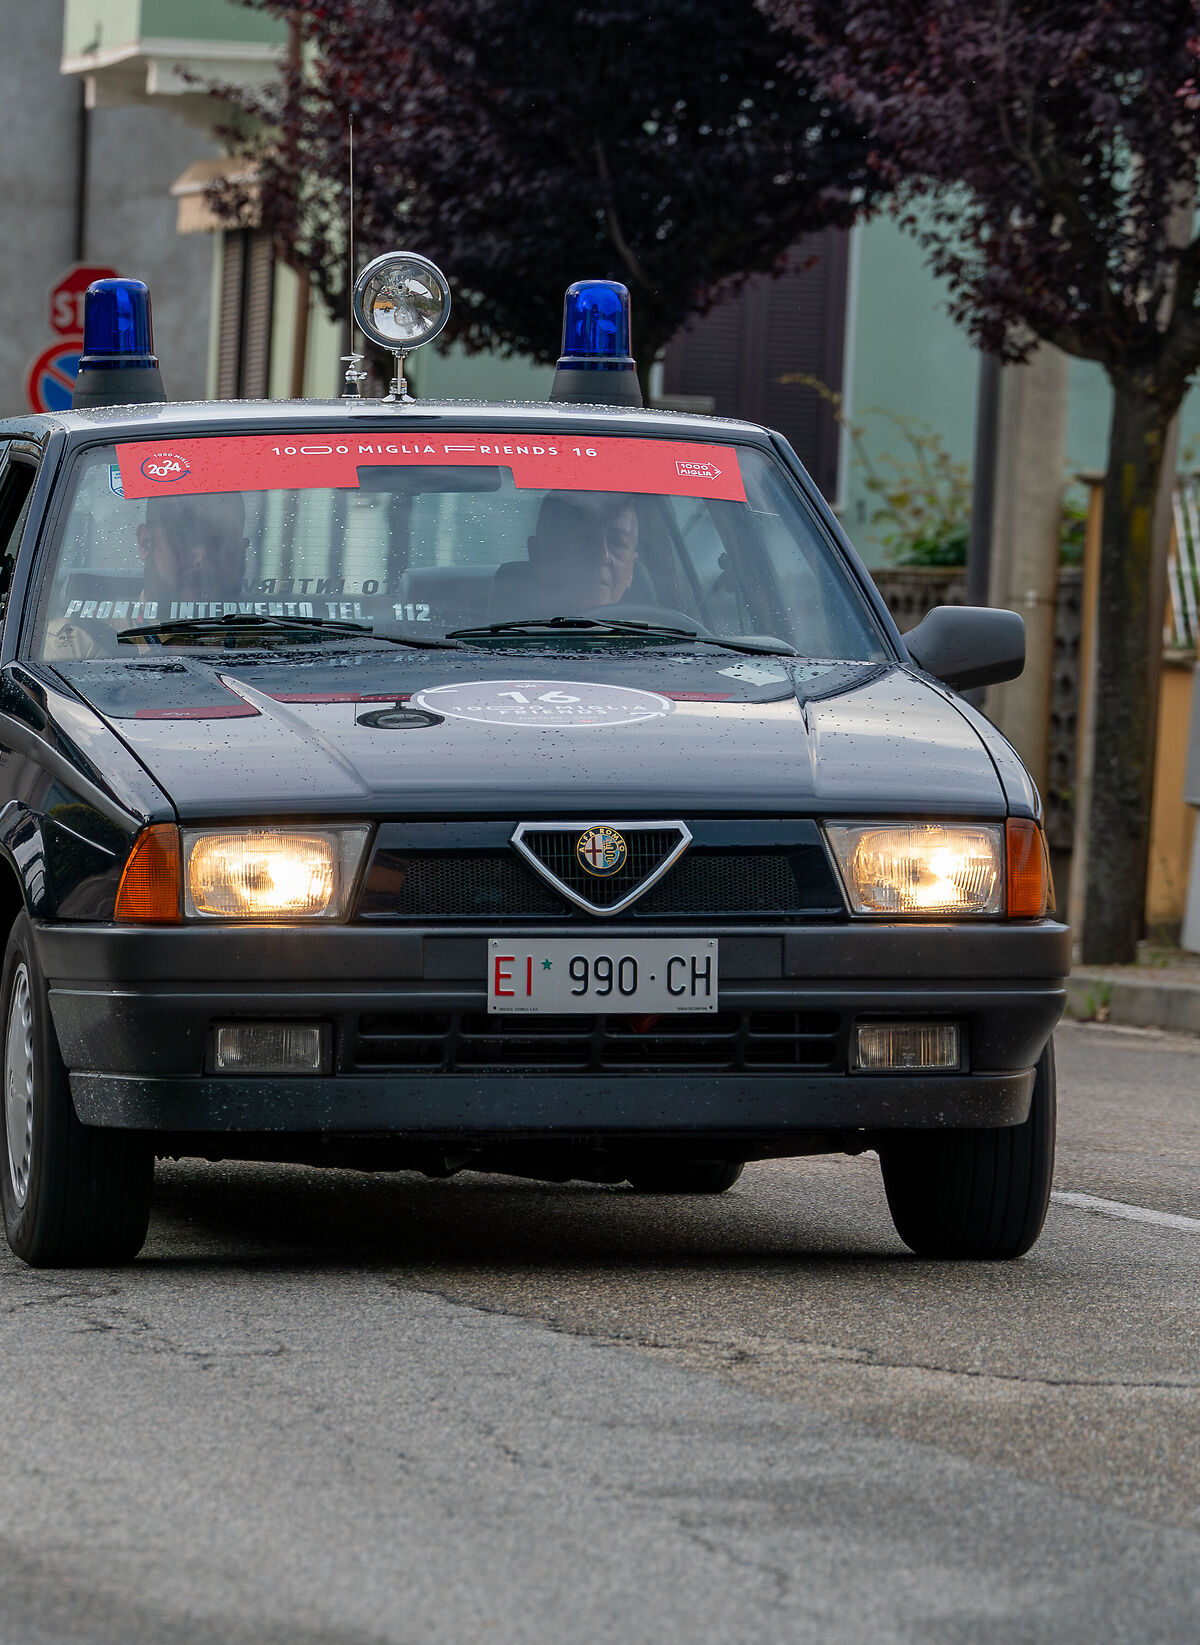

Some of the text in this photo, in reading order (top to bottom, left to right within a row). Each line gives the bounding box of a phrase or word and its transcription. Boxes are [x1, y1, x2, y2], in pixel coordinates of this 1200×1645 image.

[272, 445, 598, 457] 1000 MIGLIA FRIENDS 16
[147, 459, 182, 477] 2024
[680, 463, 709, 471] 1000
[680, 468, 713, 477] MIGLIA
[65, 600, 159, 619] PRONTO
[325, 602, 374, 620] TEL.
[392, 603, 431, 622] 112
[497, 691, 581, 704] 16
[578, 828, 625, 853] ALFA ROMEO
[494, 955, 712, 997] EI 990 CH
